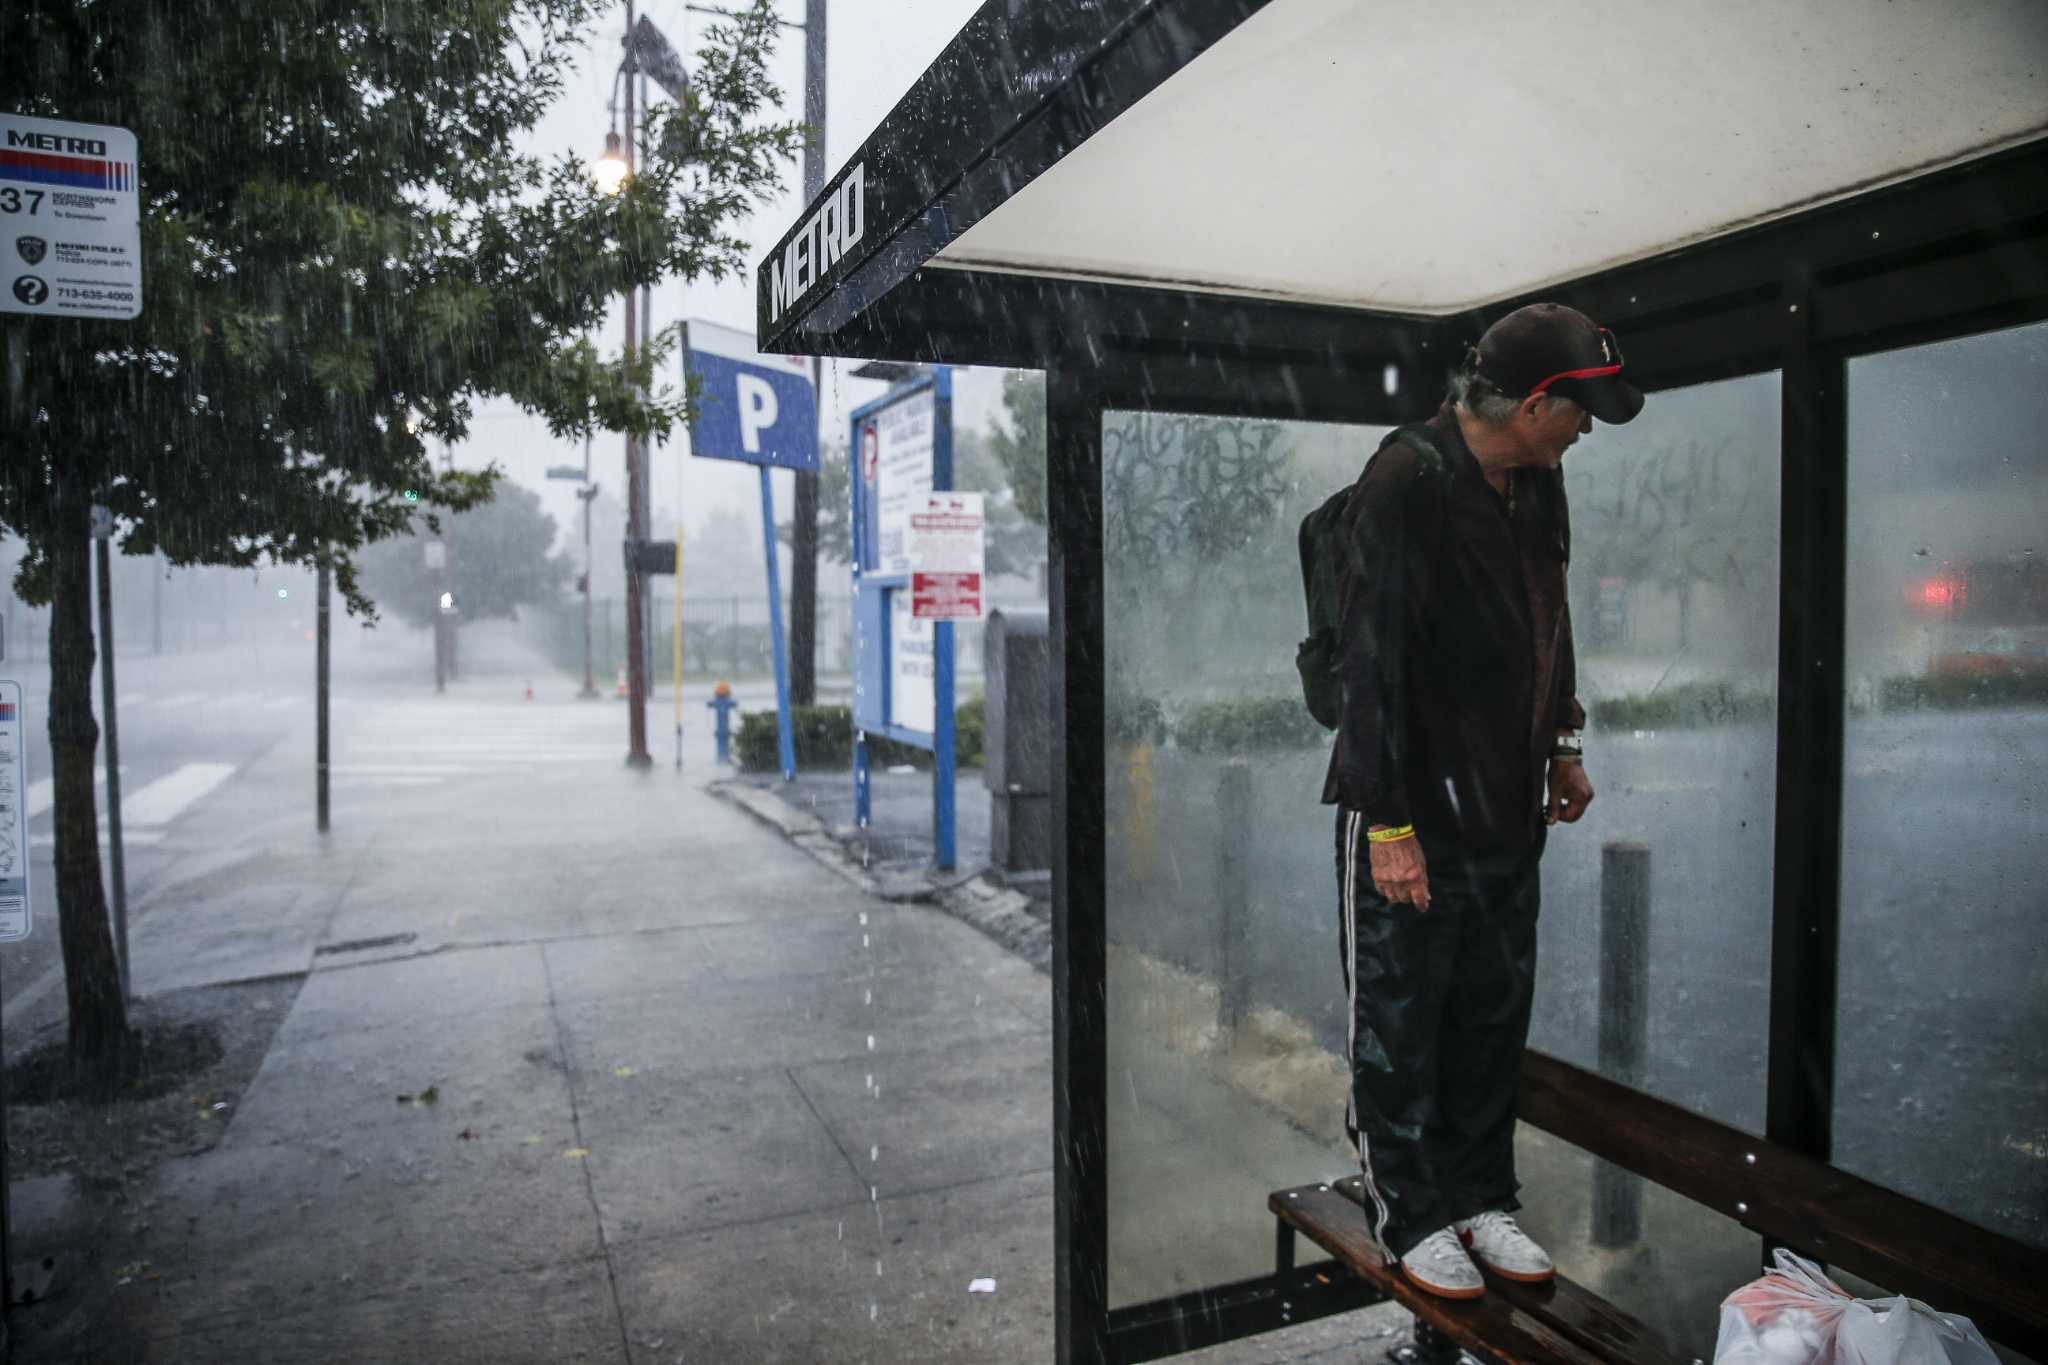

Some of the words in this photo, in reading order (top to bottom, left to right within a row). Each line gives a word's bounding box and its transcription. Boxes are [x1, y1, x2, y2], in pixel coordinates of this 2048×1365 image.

[8, 130, 106, 155] METRO
[0, 187, 45, 216] 37
[771, 162, 864, 324] METRO
[57, 288, 134, 302] 713-635-4000
[736, 372, 779, 453] P
